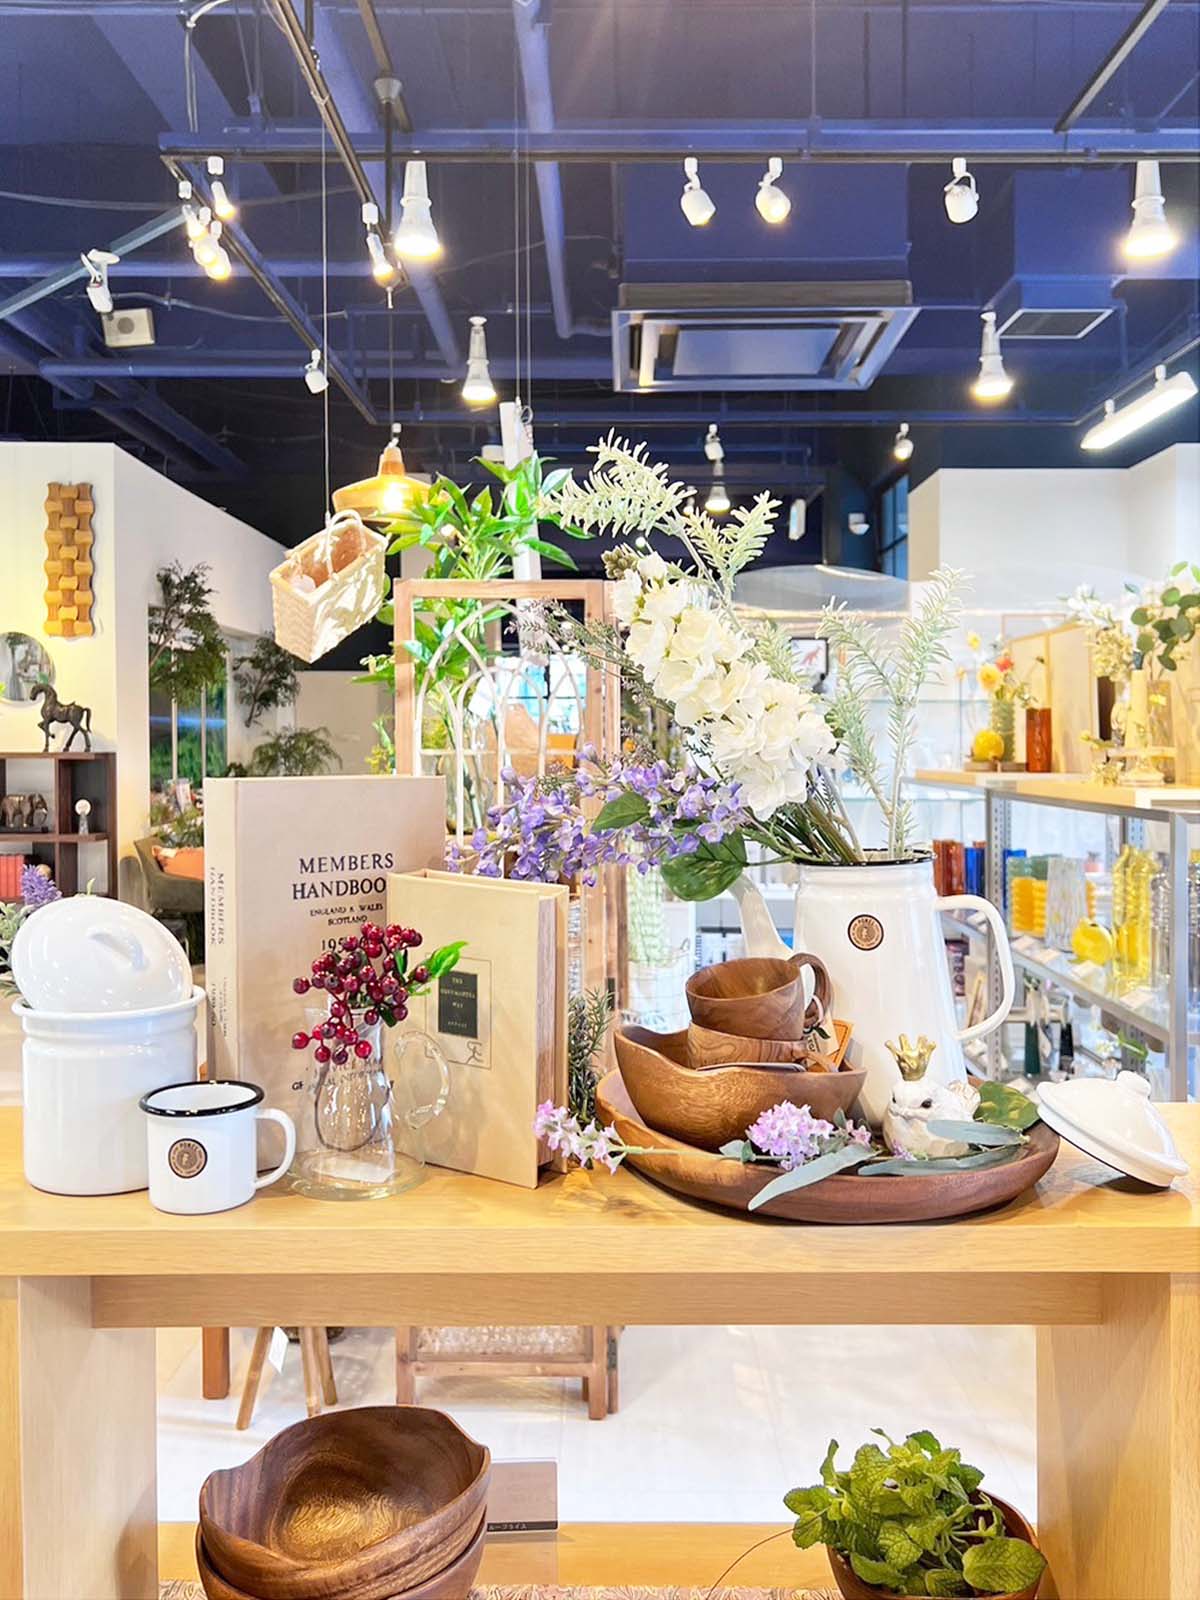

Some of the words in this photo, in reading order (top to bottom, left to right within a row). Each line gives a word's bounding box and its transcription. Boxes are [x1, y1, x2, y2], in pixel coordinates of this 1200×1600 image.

[299, 852, 394, 874] MEMBERS
[292, 877, 387, 900] HANDBOO
[310, 906, 347, 917] ENGLAND
[359, 903, 384, 912] WALES
[328, 914, 368, 926] SCOTLAND
